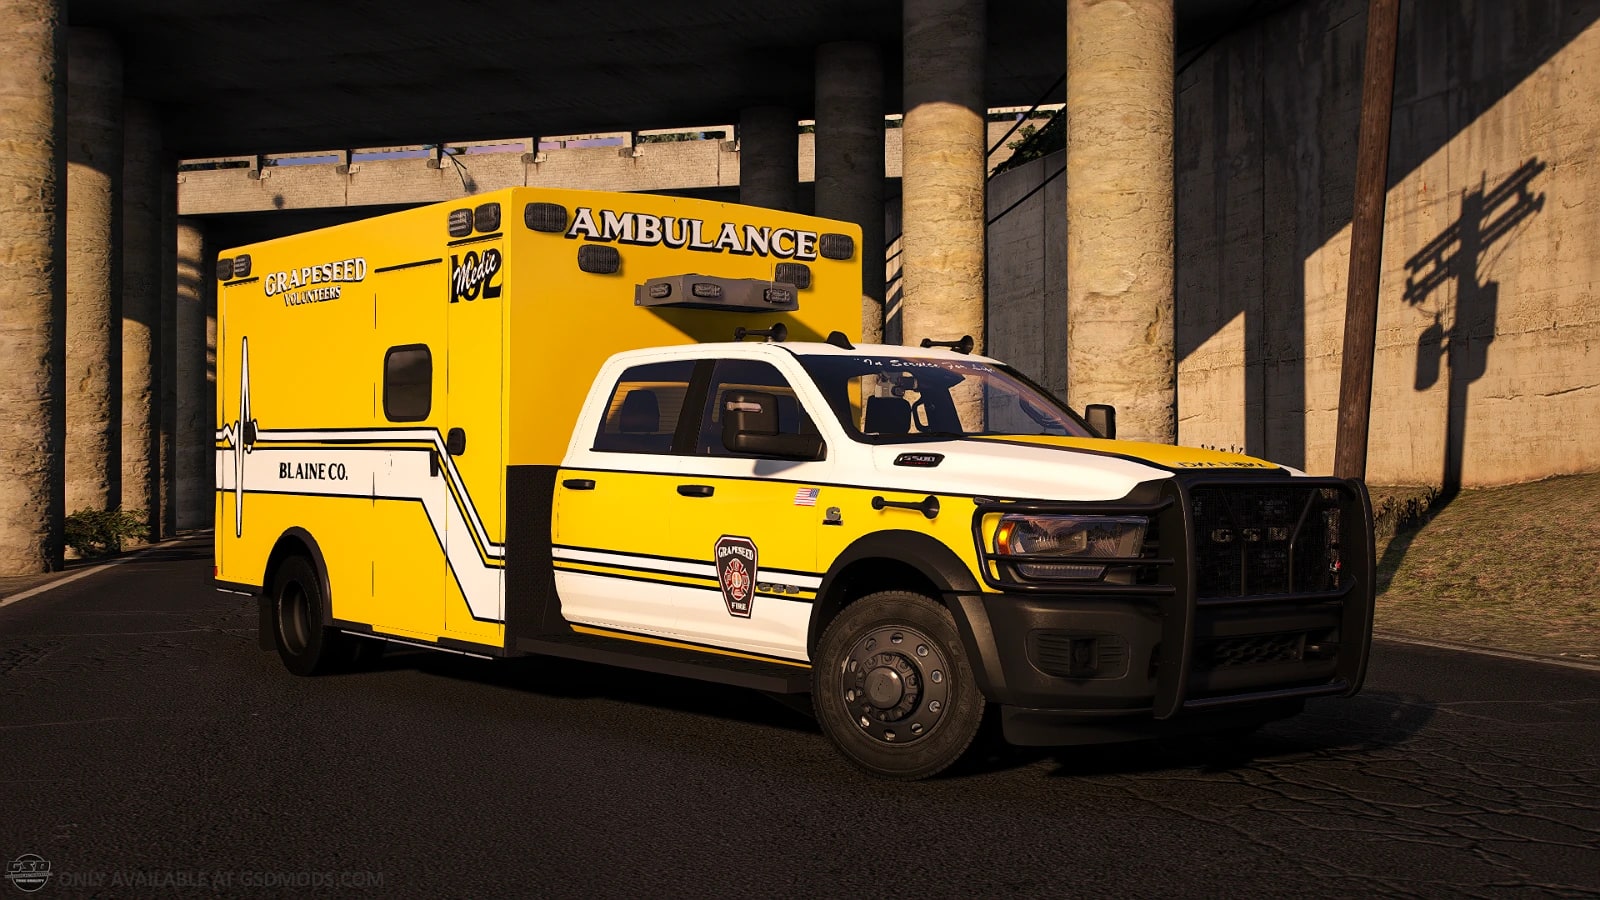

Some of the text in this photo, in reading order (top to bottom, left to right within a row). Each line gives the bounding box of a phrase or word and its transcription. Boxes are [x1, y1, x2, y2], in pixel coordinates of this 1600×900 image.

[565, 206, 819, 262] AMBULANCE
[264, 256, 368, 298] GRAPESEED
[453, 250, 497, 295] Medic
[283, 284, 342, 307] VOLUNTEERS
[279, 462, 348, 481] BLAINE CO.
[718, 546, 754, 561] GRAPESEED
[731, 602, 747, 610] FIRE
